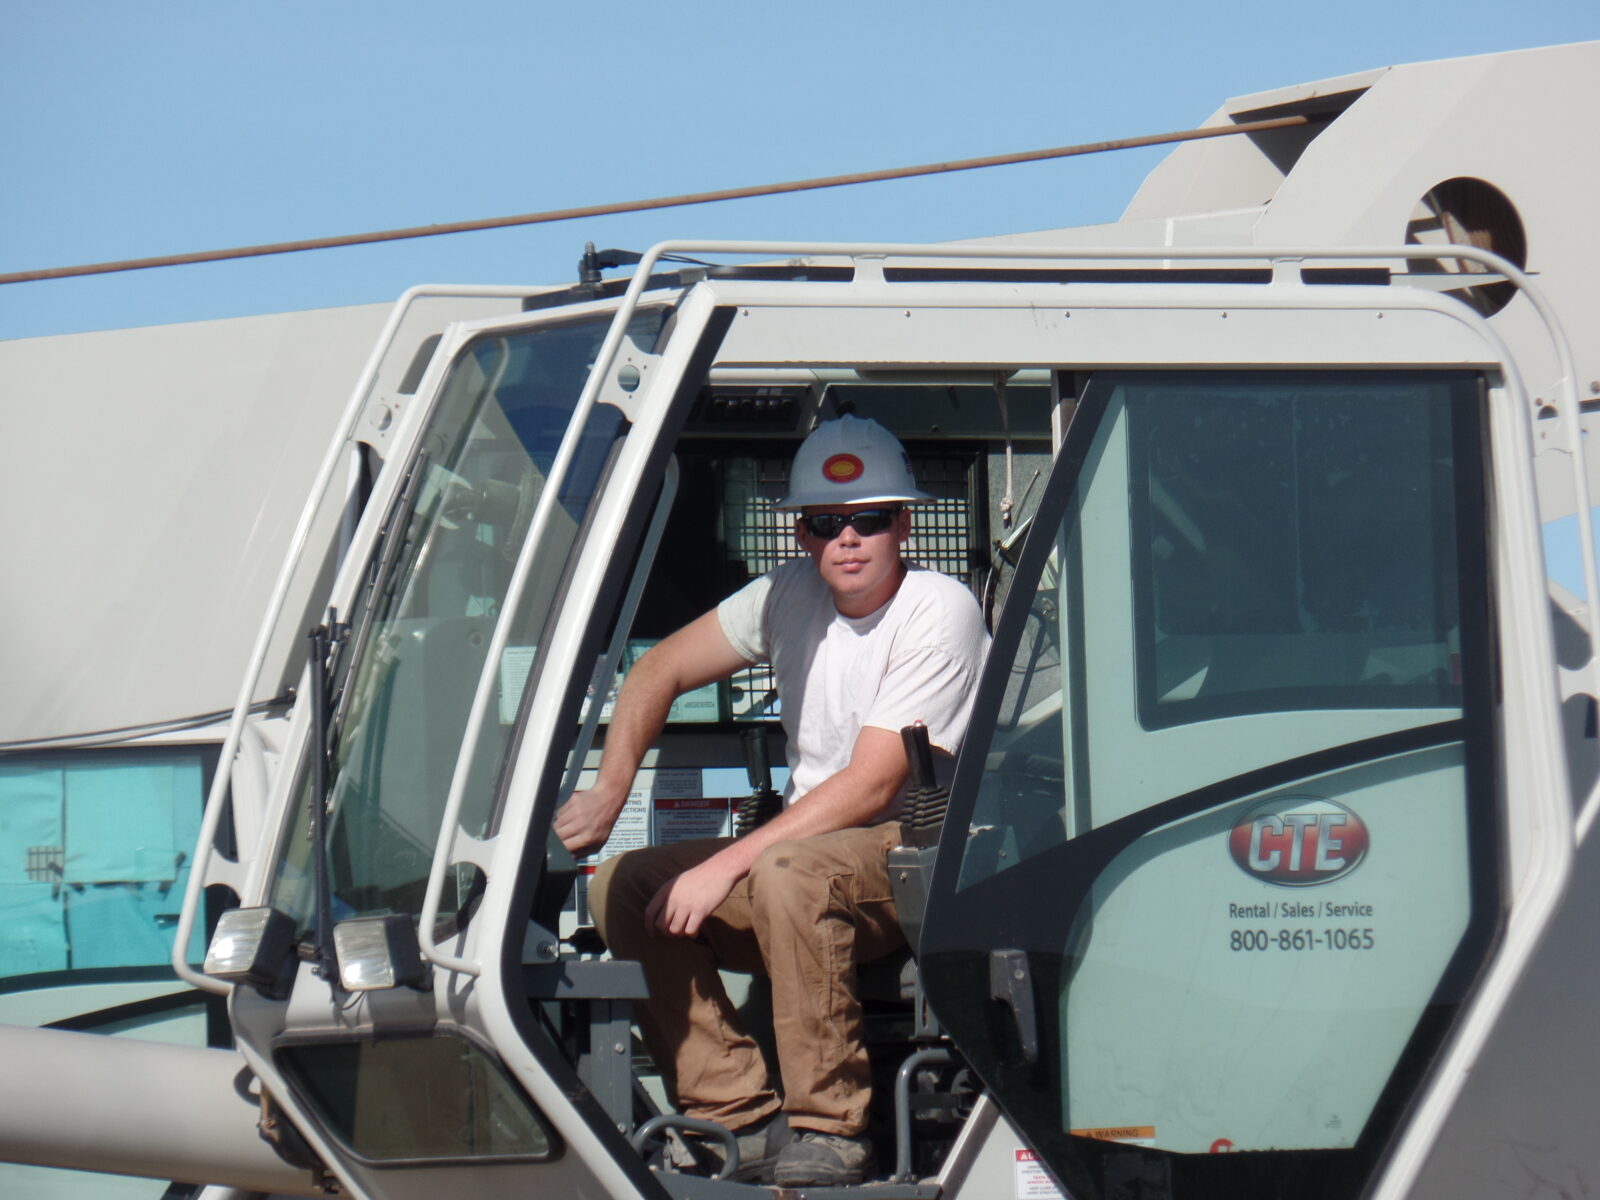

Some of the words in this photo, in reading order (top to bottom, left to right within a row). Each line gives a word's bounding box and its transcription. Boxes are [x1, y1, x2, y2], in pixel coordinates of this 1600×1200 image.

[1248, 813, 1348, 872] CTE
[1229, 903, 1270, 919] Rental
[1281, 902, 1314, 918] Sales
[1326, 901, 1373, 917] Service
[1230, 928, 1374, 951] 800-861-1065
[1095, 1129, 1140, 1139] WARNING
